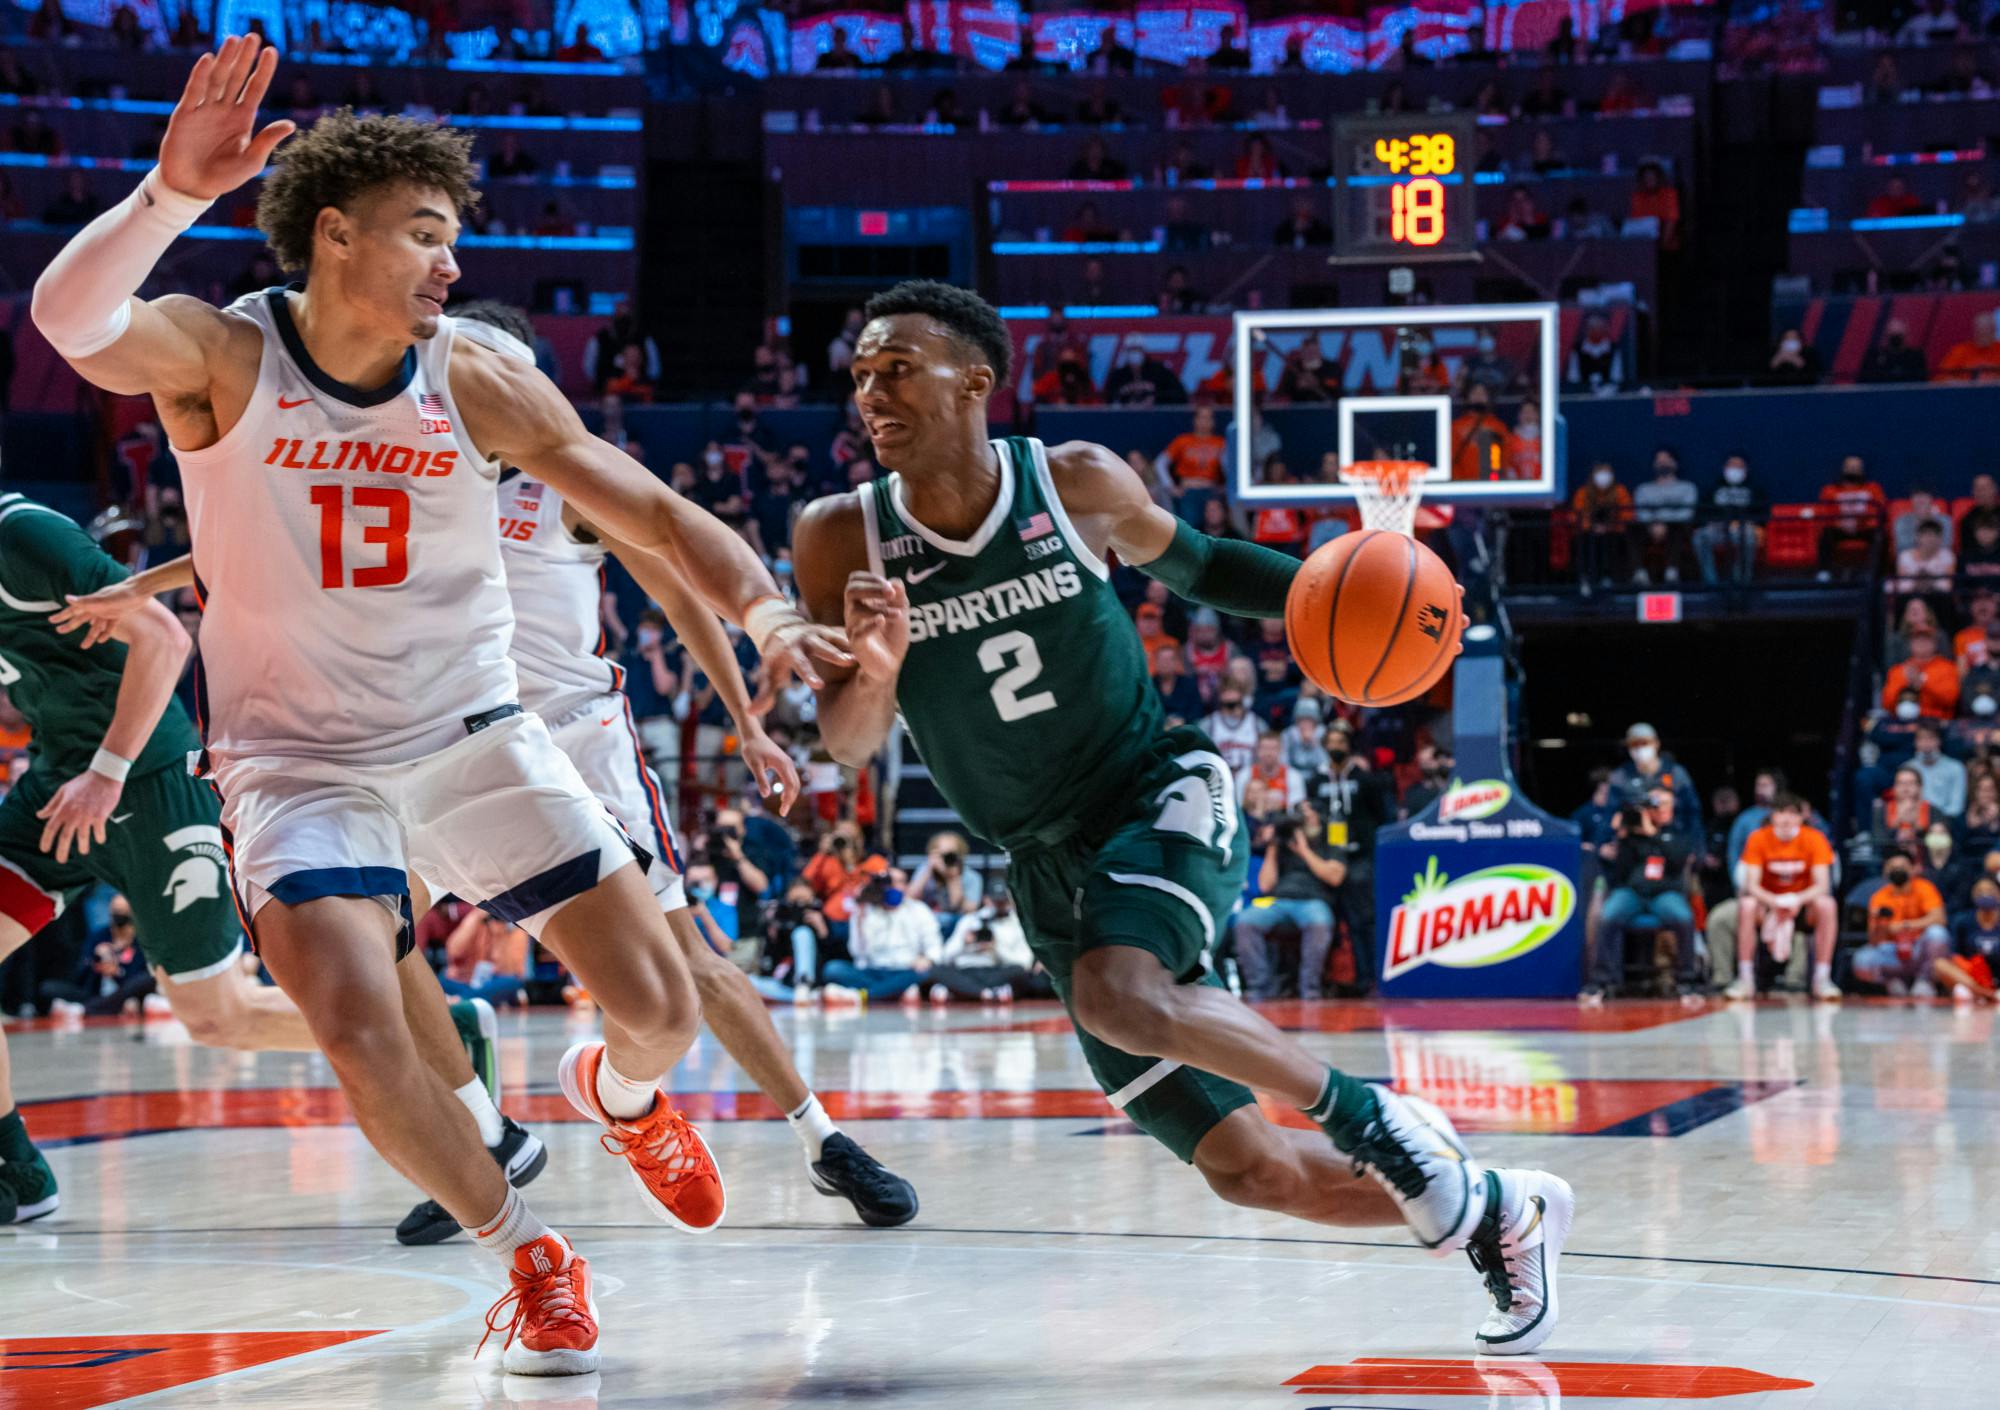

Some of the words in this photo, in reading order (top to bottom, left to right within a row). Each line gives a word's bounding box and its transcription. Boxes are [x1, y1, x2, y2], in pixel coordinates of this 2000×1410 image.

[1375, 133, 1455, 175] 4:38
[1390, 178, 1446, 247] 18
[264, 438, 459, 477] ILLINOIS
[310, 485, 411, 589] 13
[909, 561, 1083, 643] SPARTANS
[976, 629, 1058, 722] 2
[1391, 881, 1556, 968] LIBMAN
